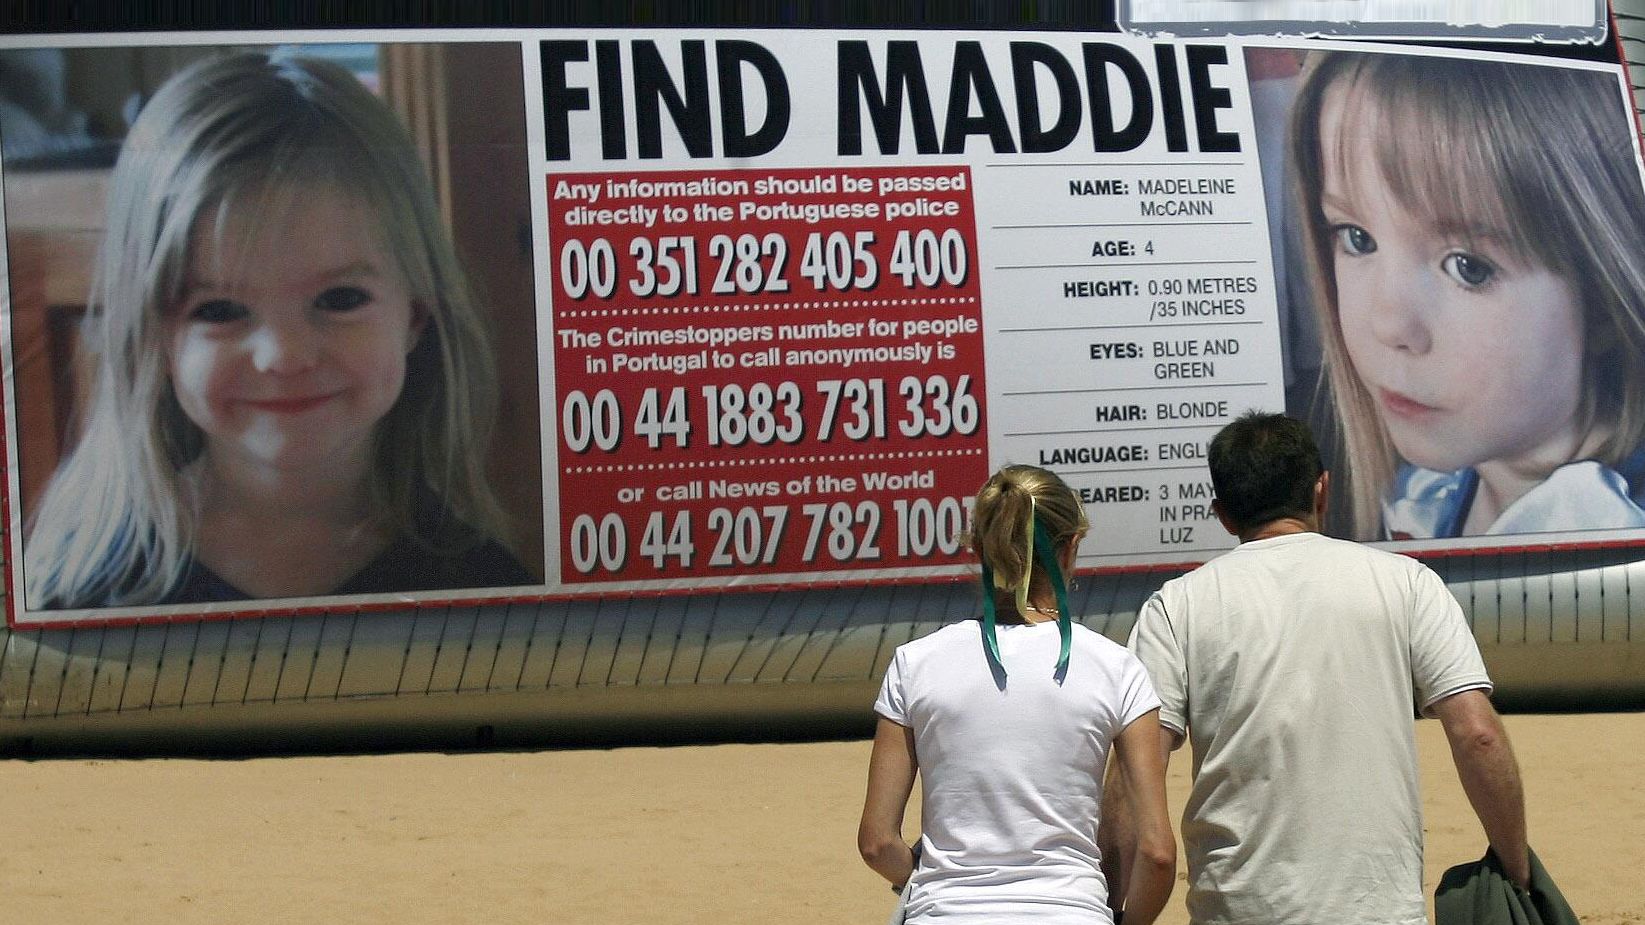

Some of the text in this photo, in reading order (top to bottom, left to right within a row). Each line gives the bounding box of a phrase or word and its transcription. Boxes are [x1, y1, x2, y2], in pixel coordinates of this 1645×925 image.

[539, 39, 1241, 161] FIND MADDIE
[554, 173, 966, 202] Any information should be passed
[1069, 179, 1236, 196] NAME: MADELEINE
[565, 199, 959, 227] directly to the Portuguese police
[1141, 200, 1213, 217] McCANN
[1092, 241, 1154, 257] AGE: 4
[561, 229, 966, 298] 00 351 282 405 400
[1064, 277, 1257, 298] HEIGHT: 0.90 METRES
[1149, 299, 1245, 321] /35 INCHES
[558, 315, 978, 350] The Crimestoppers number for people
[586, 341, 955, 375] in Portugal to call anonymously is
[1090, 339, 1239, 359] EYES: BLUE AND
[1154, 362, 1214, 379] GREEN
[563, 375, 978, 452] 00 44 1883 731 336
[1096, 401, 1228, 422] HAIR: BLONDE
[1040, 446, 1148, 465] LANGUAGE:
[618, 470, 934, 502] or call News of the World
[1159, 484, 1169, 500] 3
[1179, 482, 1215, 499] MAY
[1160, 503, 1218, 521] IN PRA
[570, 512, 625, 573] 00
[640, 510, 693, 569] 44
[708, 505, 788, 567] 207
[802, 501, 880, 562] 782
[1160, 526, 1194, 544] LUZ
